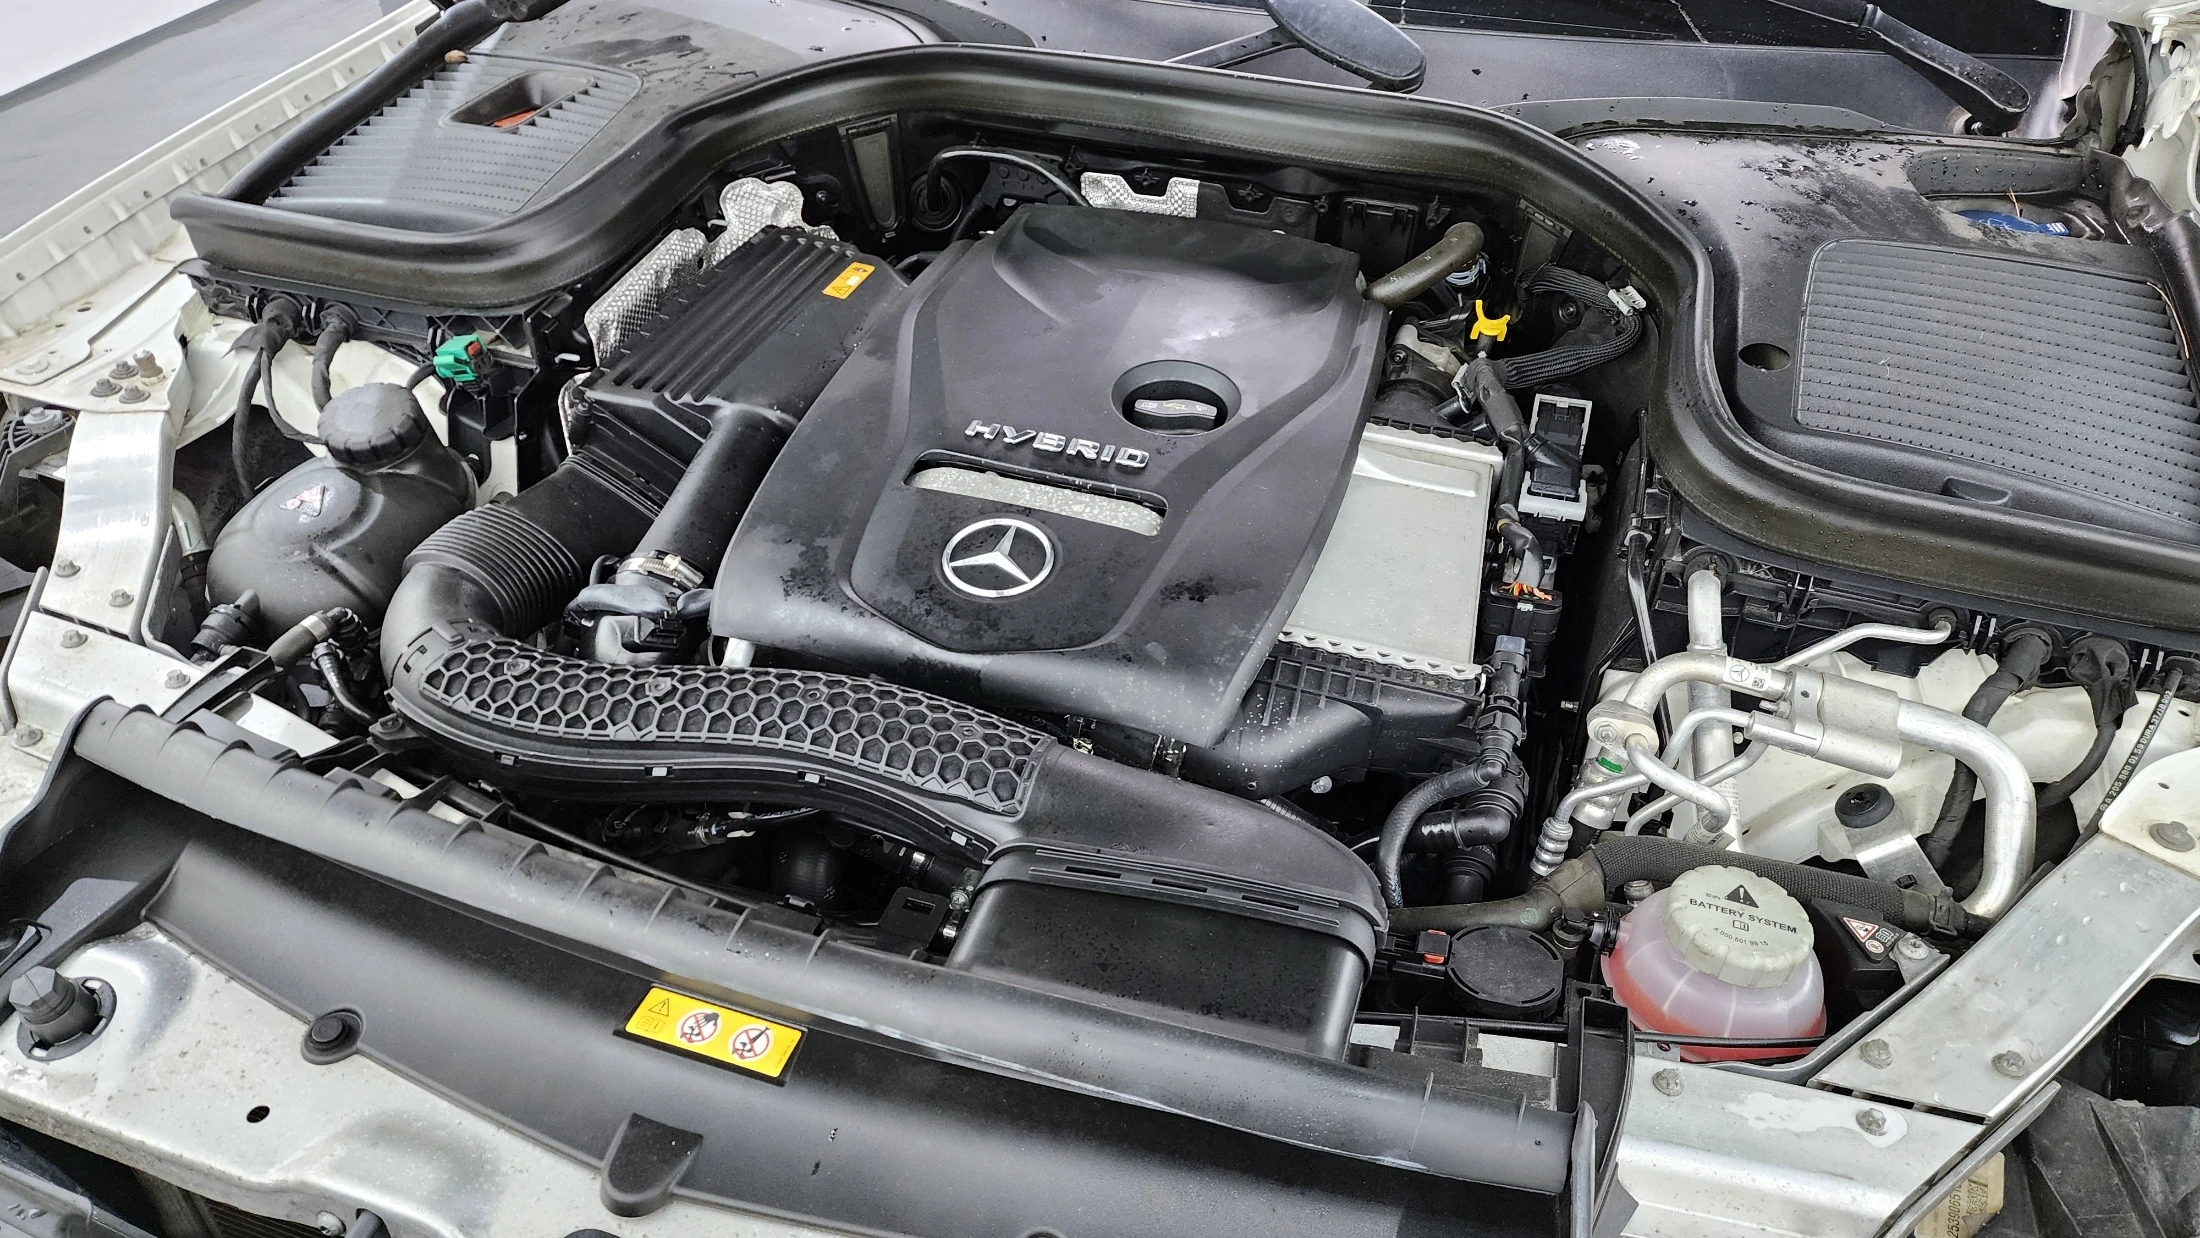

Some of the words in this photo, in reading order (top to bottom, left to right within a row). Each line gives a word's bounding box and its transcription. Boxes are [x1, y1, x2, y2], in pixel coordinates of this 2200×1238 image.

[965, 420, 1149, 468] HYBRID
[2109, 781, 2122, 796] 205
[2128, 755, 2138, 765] 01
[2134, 743, 2144, 755] 59
[2139, 724, 2154, 744] DURA
[1690, 898, 1744, 918] BATTERY
[1748, 914, 1797, 933] SYSTEM
